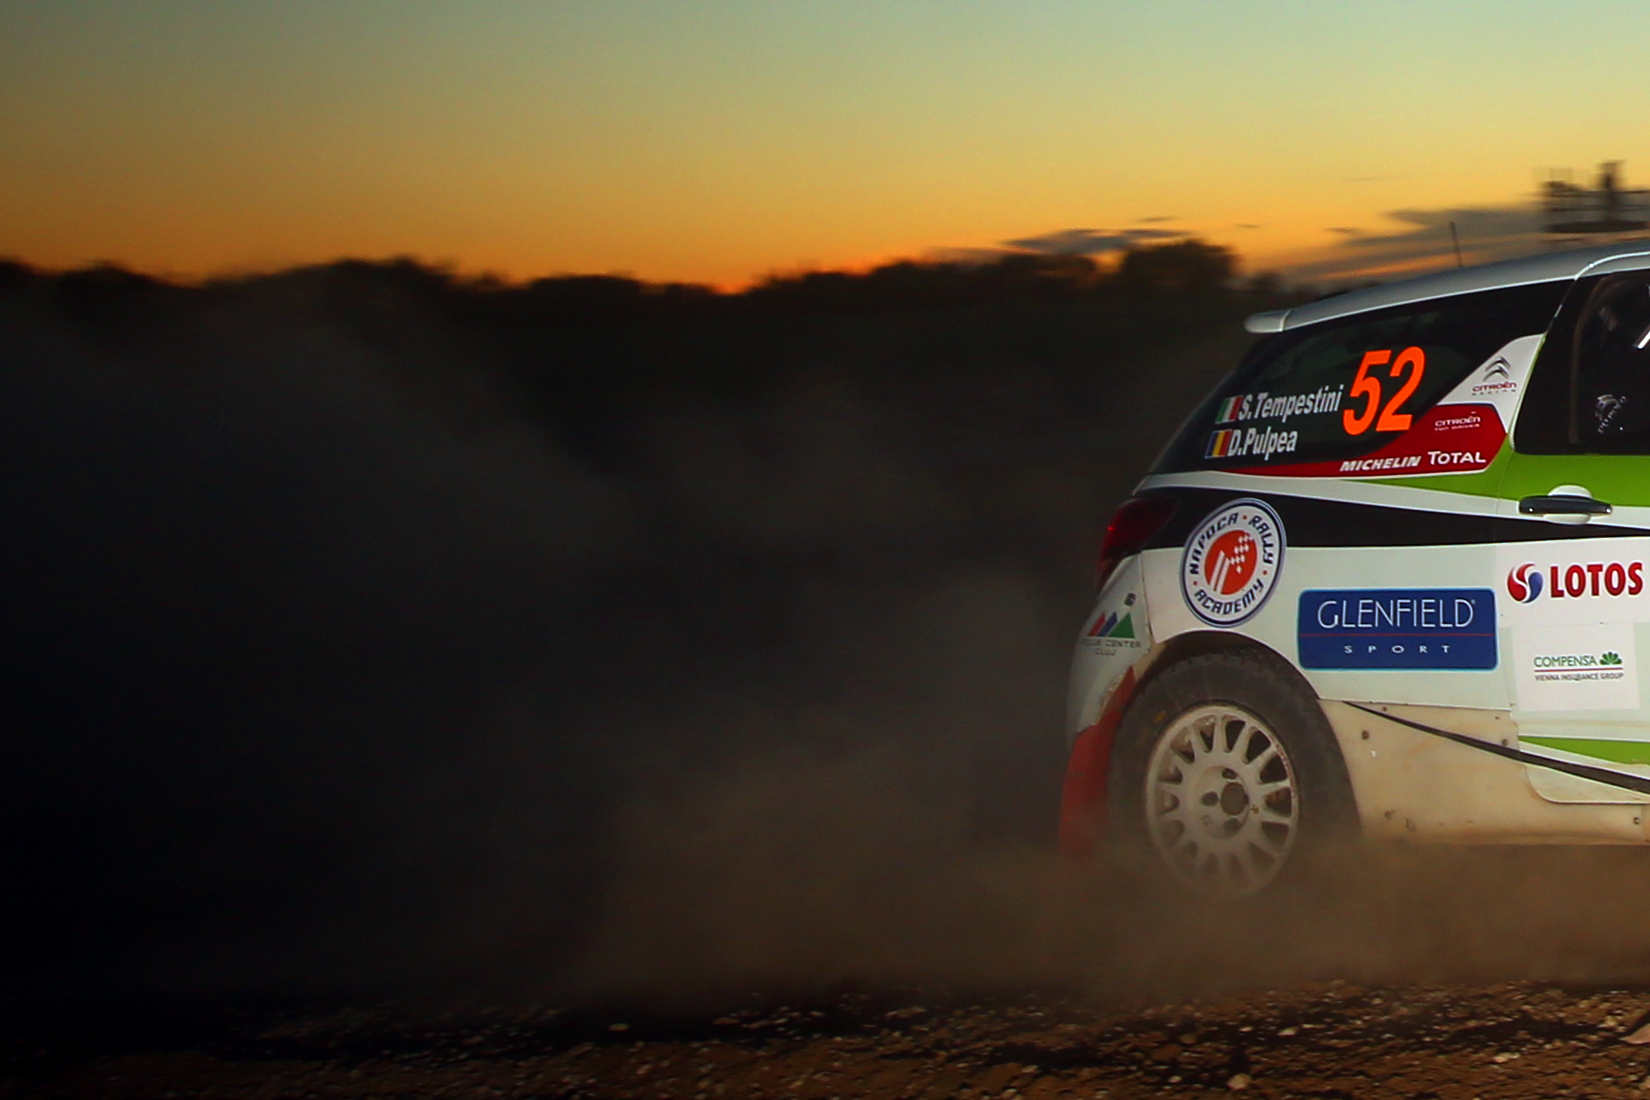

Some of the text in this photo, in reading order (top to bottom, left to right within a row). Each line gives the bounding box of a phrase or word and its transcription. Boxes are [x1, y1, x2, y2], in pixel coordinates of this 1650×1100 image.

[1238, 384, 1344, 423] S.Tempestini
[1343, 346, 1425, 435] 52
[1227, 426, 1298, 460] D.Pulpea
[1340, 451, 1486, 472] MICHELIN TOTAL
[1190, 512, 1274, 575] NAPOCA RALLY
[1194, 578, 1264, 615] ACADEMY
[1550, 562, 1643, 598] LOTOS
[1317, 599, 1474, 628] GLENFIELD
[1344, 645, 1450, 654] SPORT
[1534, 655, 1597, 667] COMPENSA
[1561, 673, 1599, 681] INSURANCE
[1600, 672, 1624, 680] GROUP
